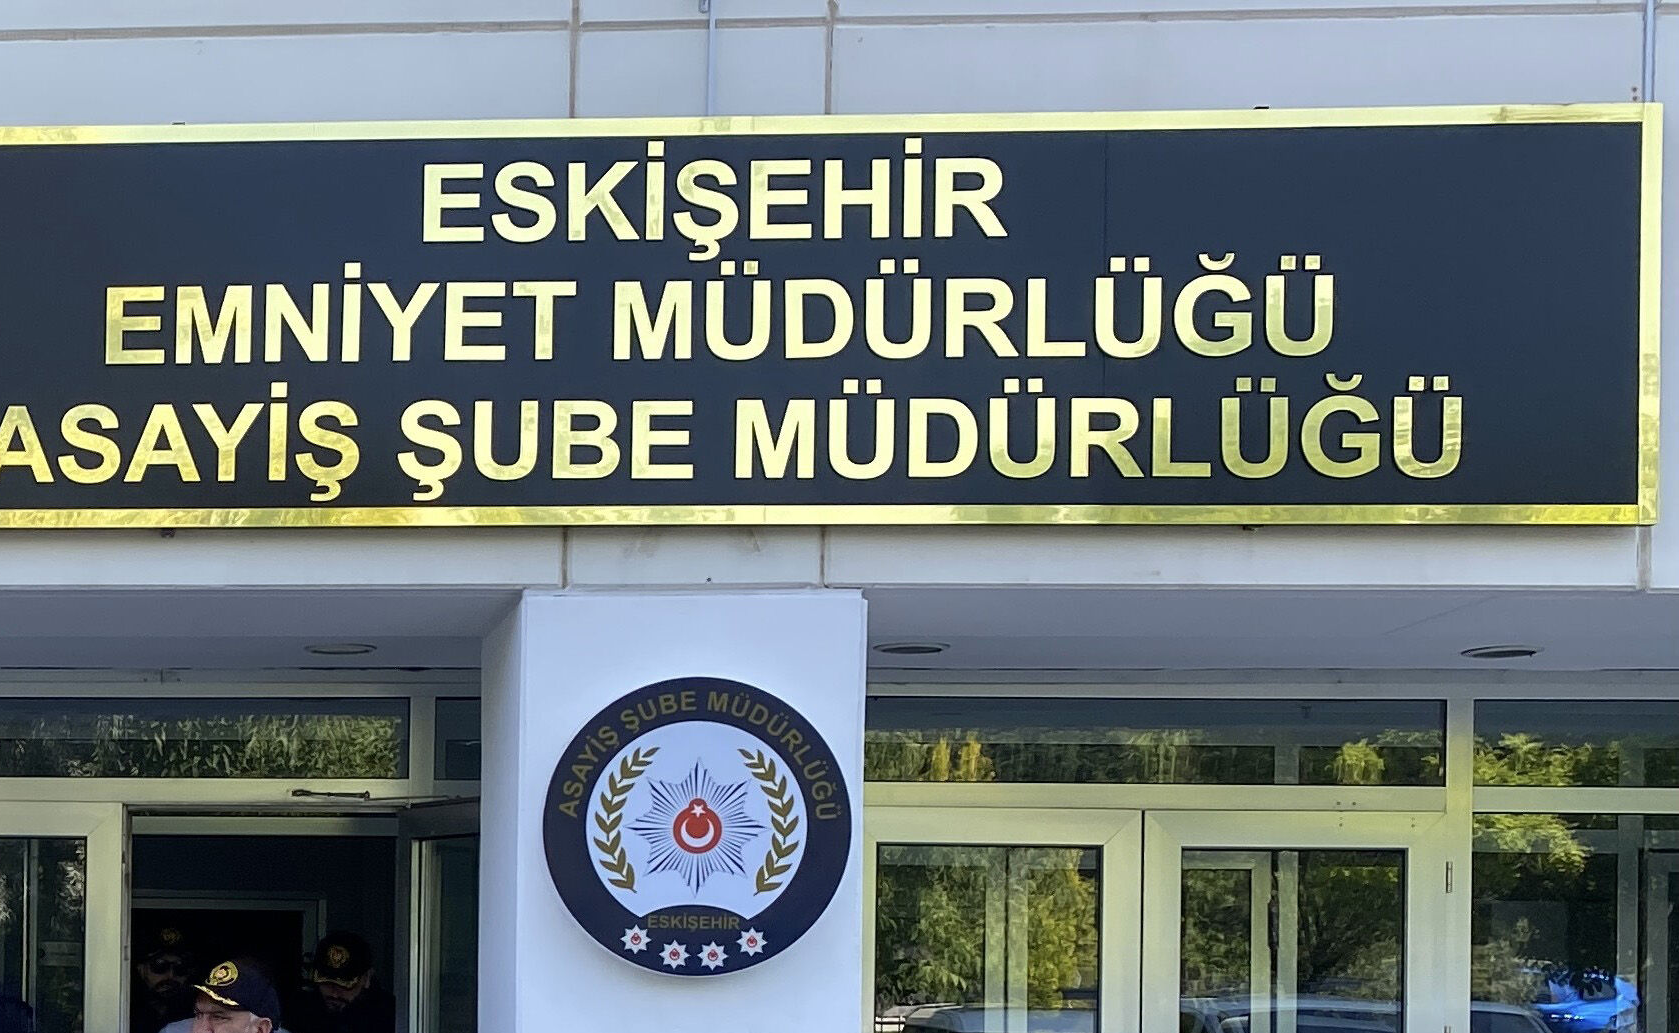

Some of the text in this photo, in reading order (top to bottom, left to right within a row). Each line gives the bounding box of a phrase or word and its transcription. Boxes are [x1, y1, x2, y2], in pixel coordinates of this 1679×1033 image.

[422, 137, 1009, 261] ESKİŞEHİR
[104, 252, 1335, 366] EMNİYET MÜDÜRLÜĞÜ
[396, 399, 695, 502] ŞUBE
[734, 373, 1463, 480] MÜDÜRLÜĞÜ
[558, 690, 842, 821] ASAYİŞ ŞUBE MÜDÜRLÜĞÜ
[646, 911, 741, 933] ESKİŞEHİR
